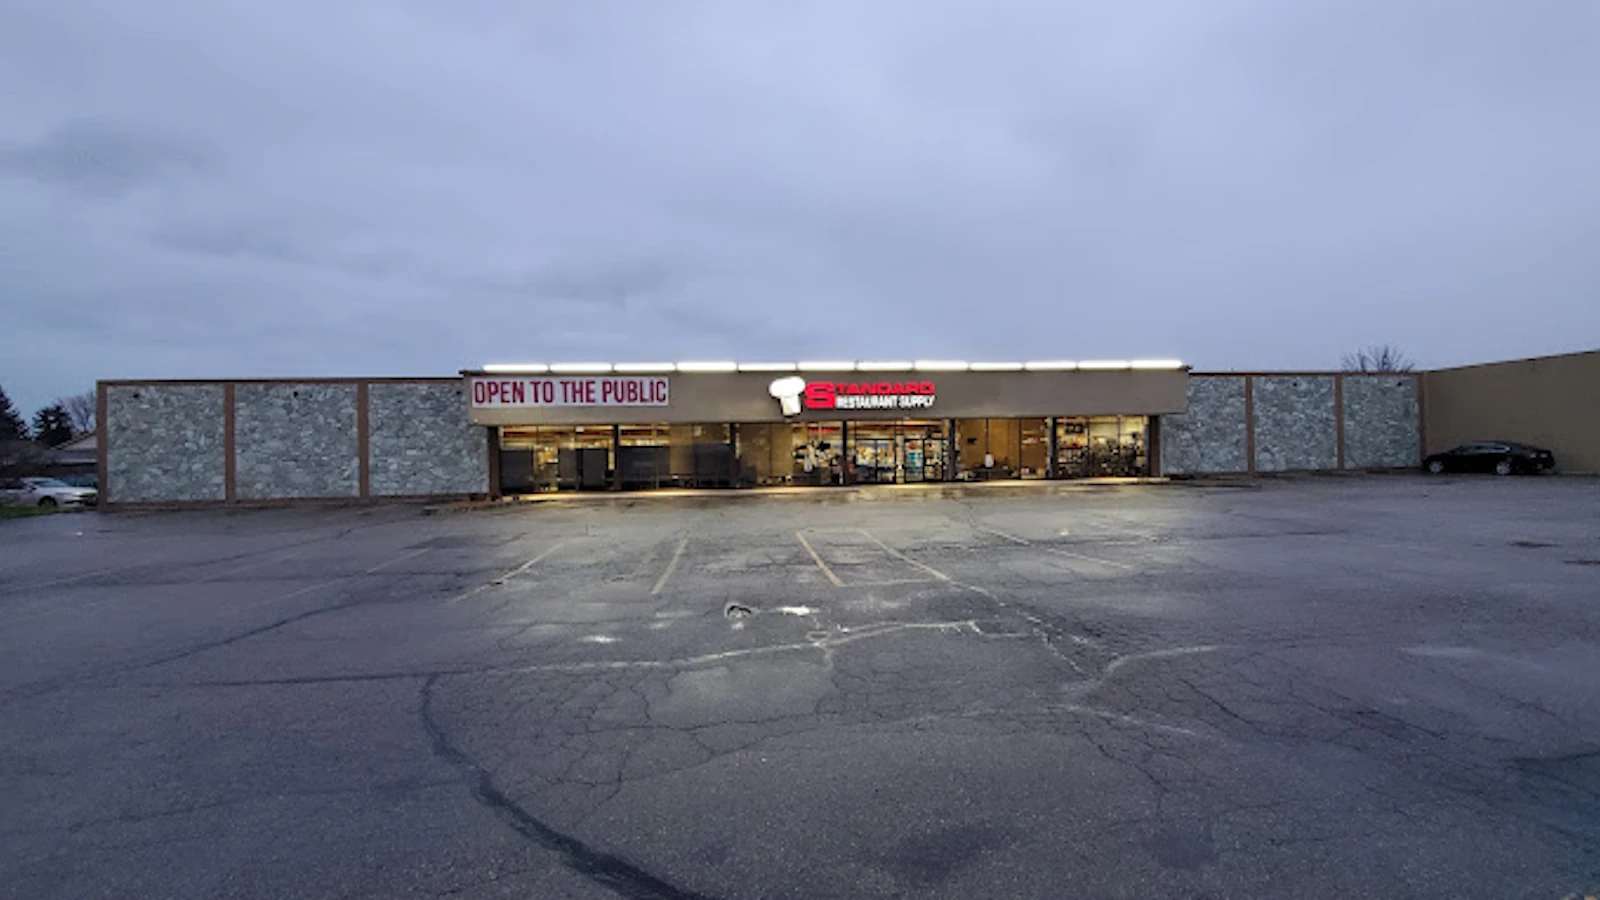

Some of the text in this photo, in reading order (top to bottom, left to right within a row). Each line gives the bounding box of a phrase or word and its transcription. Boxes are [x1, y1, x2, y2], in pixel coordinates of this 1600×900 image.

[474, 380, 666, 403] OPEN TO THE PUBLIC
[805, 381, 935, 409] STANDARD
[836, 395, 935, 408] RESTAURANT SUPPLY
